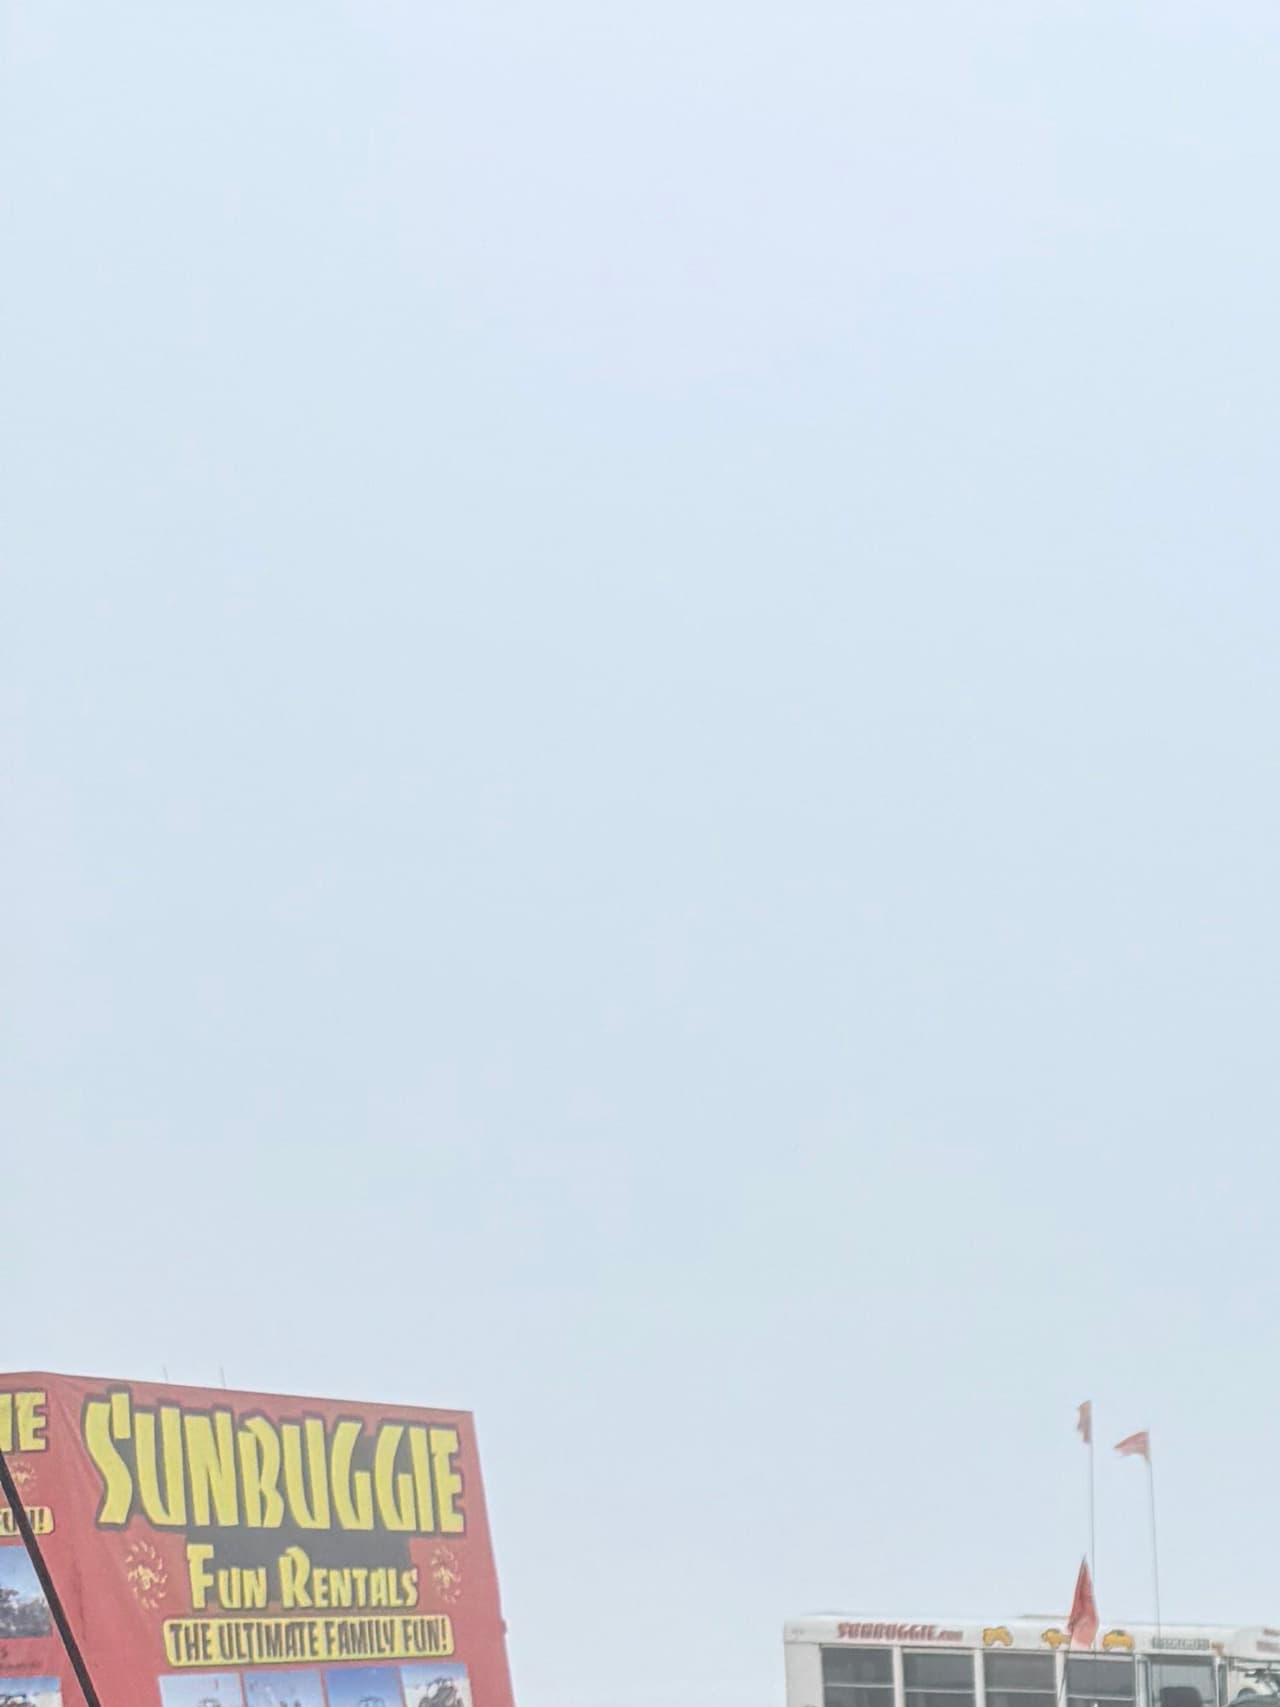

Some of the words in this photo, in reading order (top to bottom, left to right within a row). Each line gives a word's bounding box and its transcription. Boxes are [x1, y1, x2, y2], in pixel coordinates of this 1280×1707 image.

[85, 1392, 465, 1533] SUNBUGGIE
[169, 1623, 211, 1662] THE
[216, 1621, 319, 1661] ULTIMATE
[326, 1618, 395, 1656] FAMILY
[403, 1618, 447, 1652] FUN!
